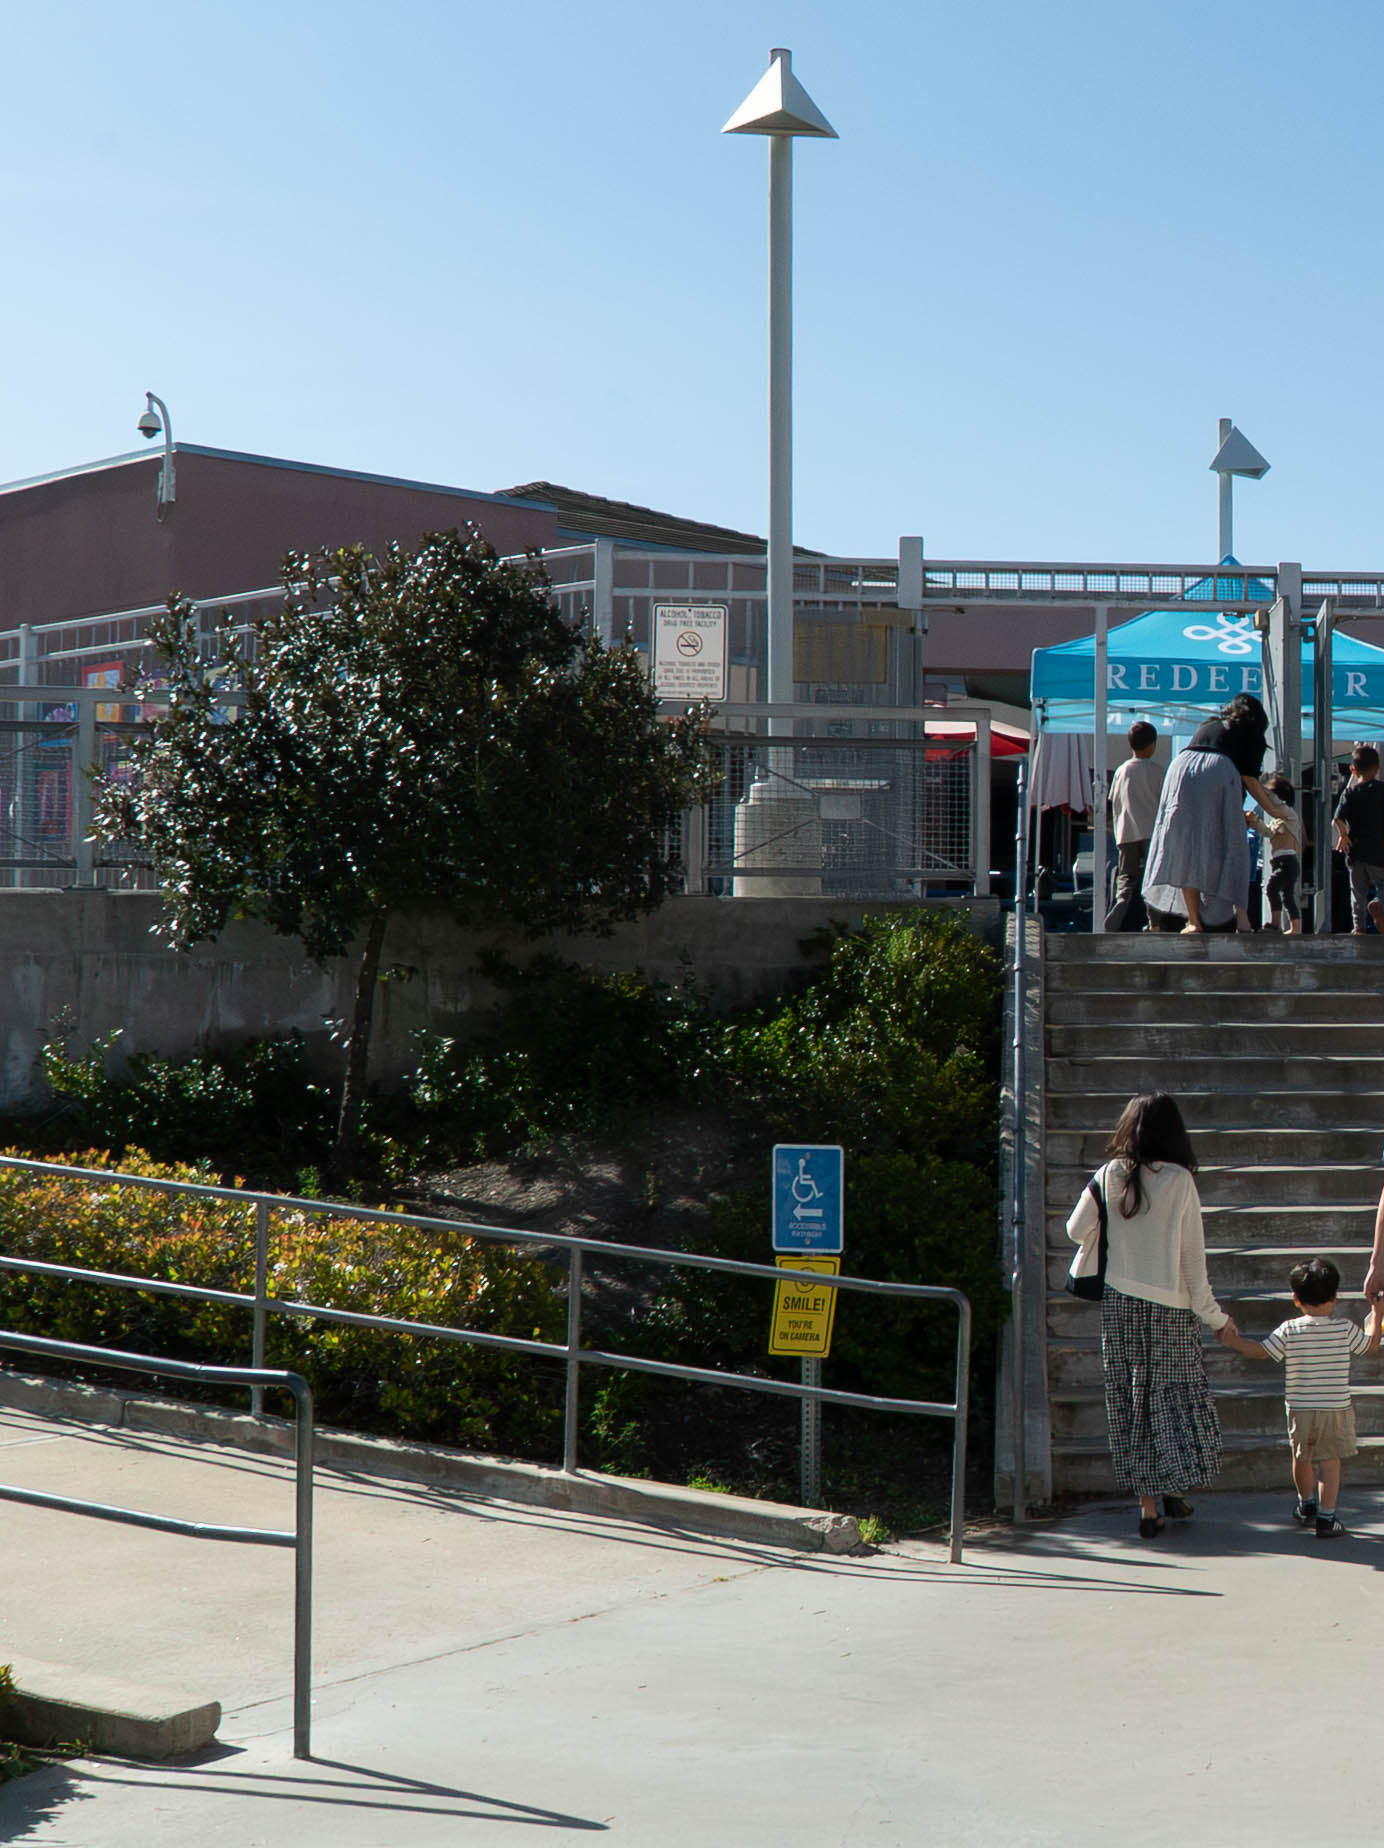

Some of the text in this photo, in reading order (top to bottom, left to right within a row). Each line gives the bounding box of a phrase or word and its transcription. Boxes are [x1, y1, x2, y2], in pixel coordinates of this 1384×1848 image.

[1107, 663, 1369, 698] REDEER
[783, 1295, 826, 1312] SMILE!
[788, 1319, 814, 1330] YOU'RE
[790, 1332, 820, 1342] CAMERA
